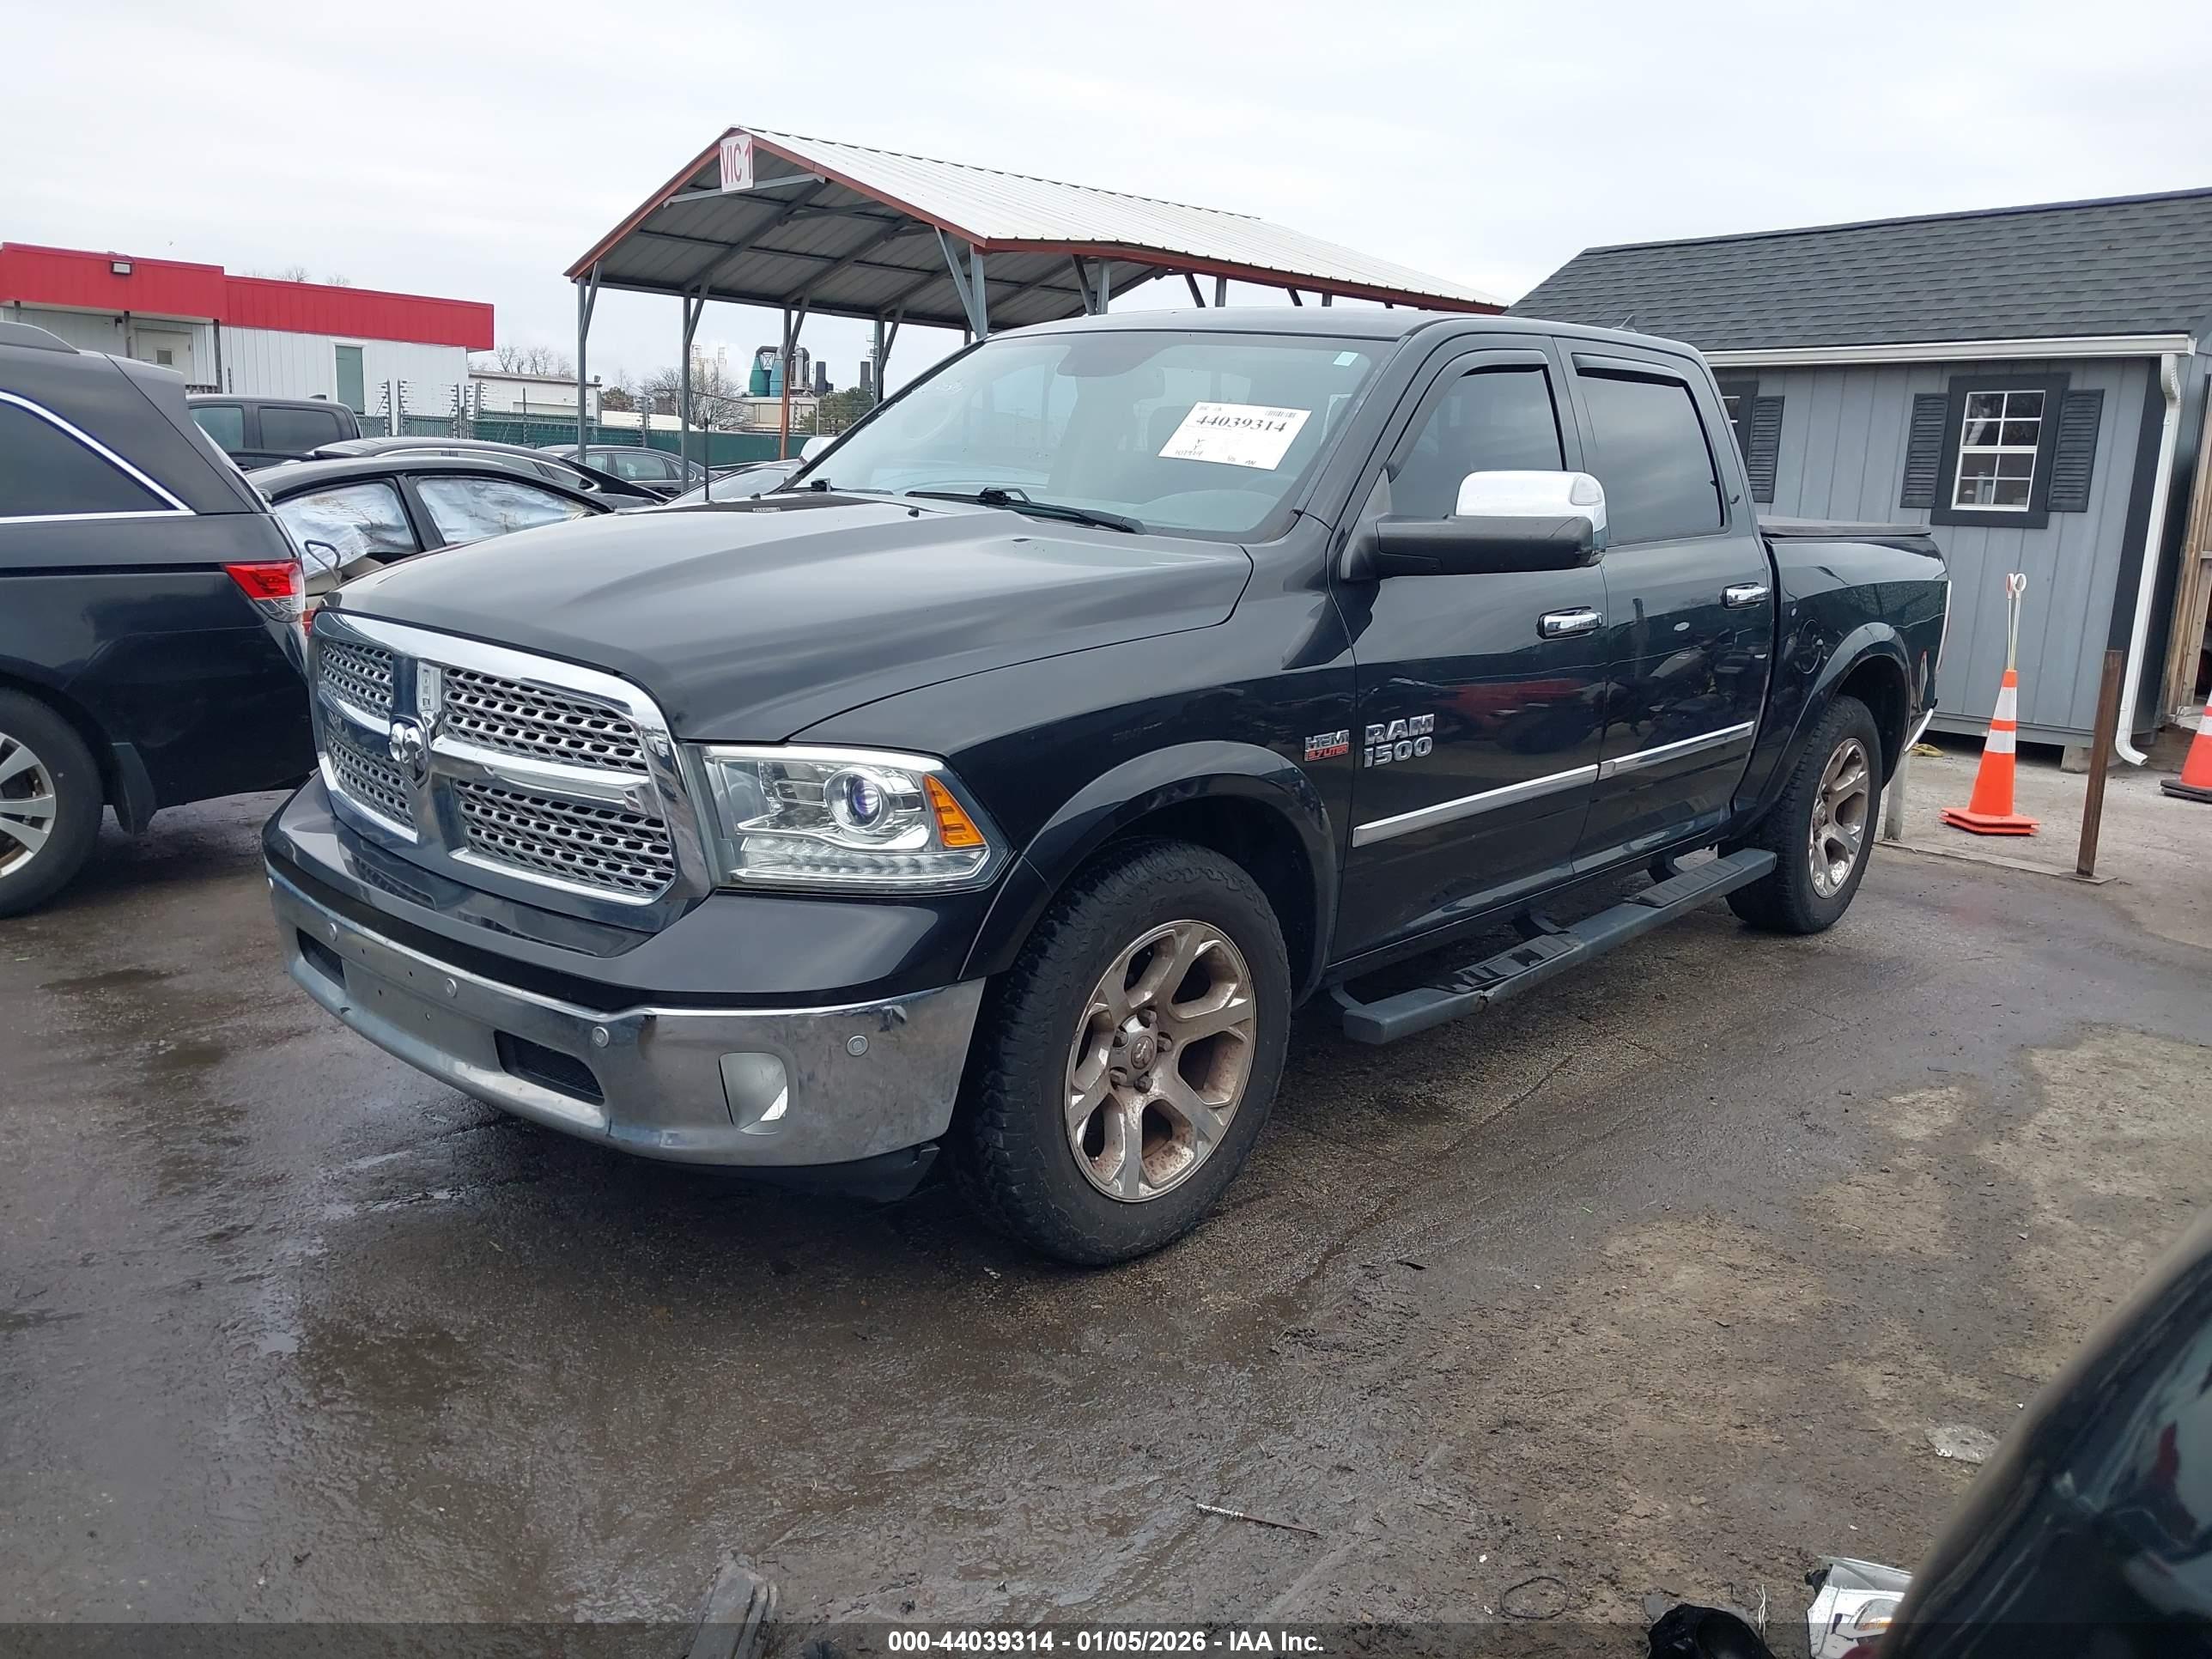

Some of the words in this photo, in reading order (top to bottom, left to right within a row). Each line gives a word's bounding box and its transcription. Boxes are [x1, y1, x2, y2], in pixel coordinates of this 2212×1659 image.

[721, 143, 742, 184] VIC
[744, 141, 751, 179] 1
[1196, 415, 1287, 433] 44039314
[1304, 729, 1349, 751] HEMI
[1364, 714, 1435, 745] RAM
[1324, 744, 1347, 757] LITER
[1364, 736, 1433, 769] 1500
